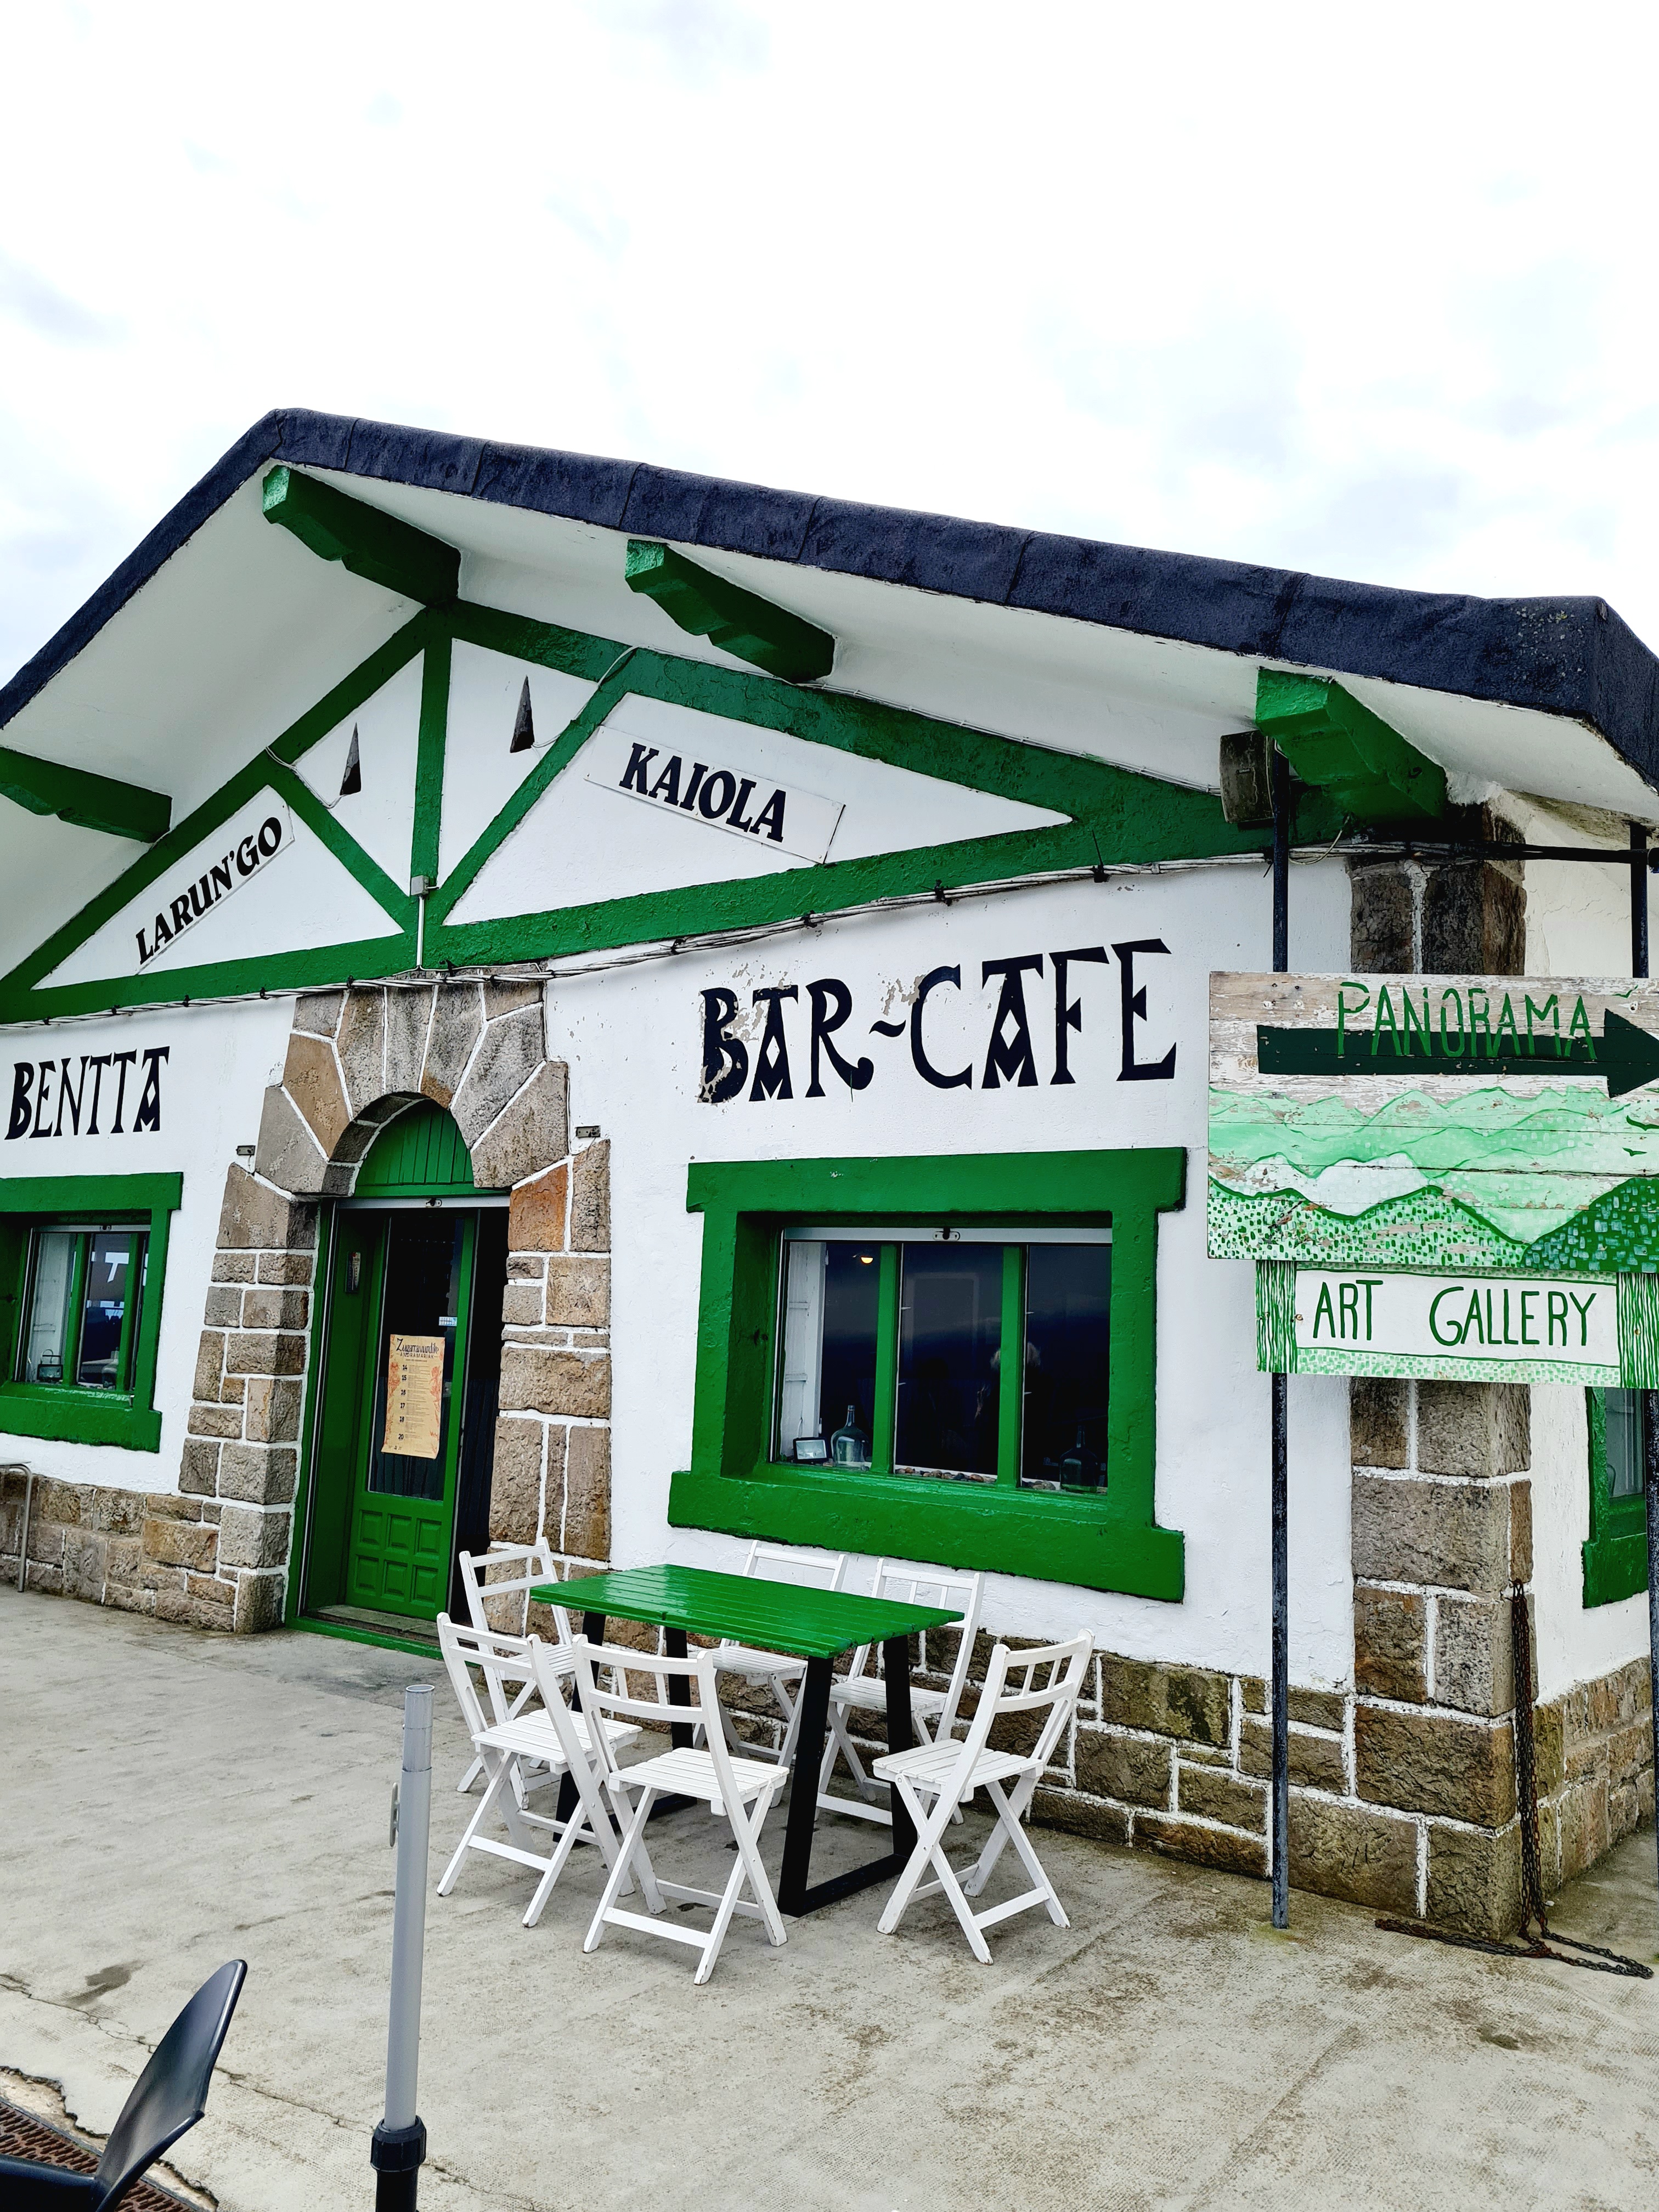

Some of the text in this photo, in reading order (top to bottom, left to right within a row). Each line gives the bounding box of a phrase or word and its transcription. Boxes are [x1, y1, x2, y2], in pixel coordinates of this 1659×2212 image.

[618, 742, 787, 843] KAIOLA
[135, 816, 283, 965] LARUN'GO
[1337, 981, 1597, 1060] PANORAMA
[4, 1046, 170, 1141] BENTTA
[1313, 1279, 1597, 1346] ART GALLERY
